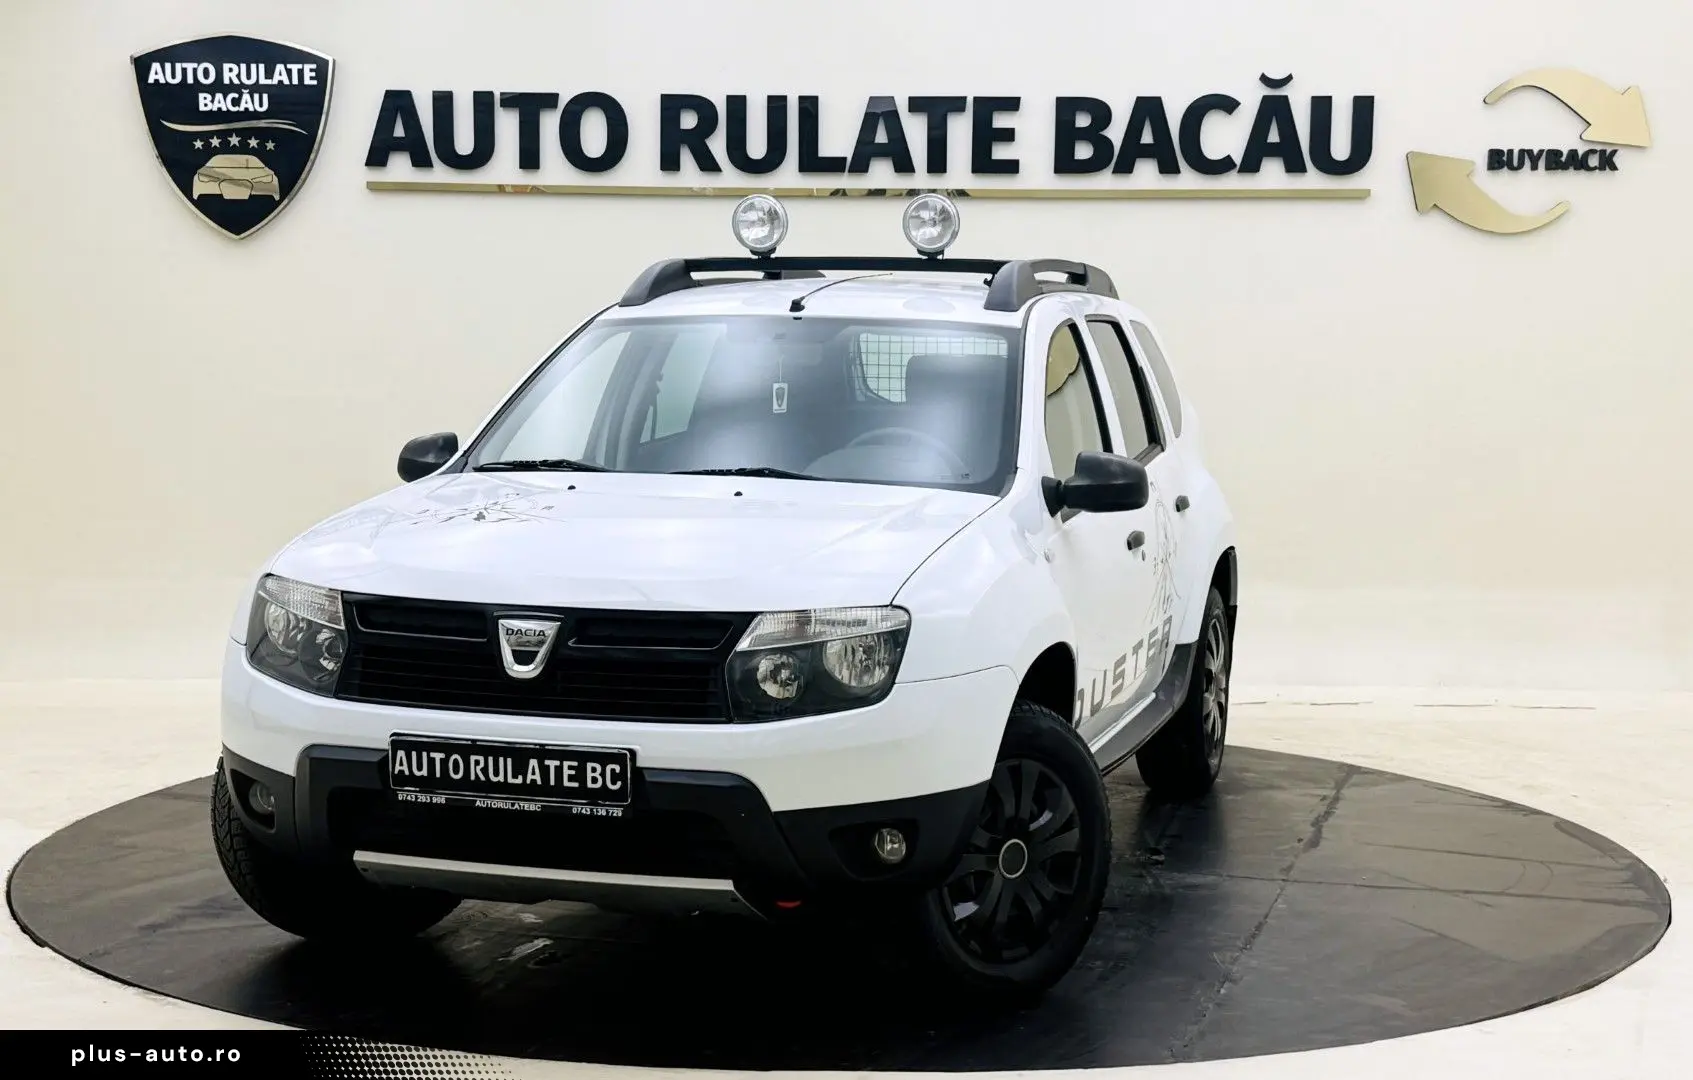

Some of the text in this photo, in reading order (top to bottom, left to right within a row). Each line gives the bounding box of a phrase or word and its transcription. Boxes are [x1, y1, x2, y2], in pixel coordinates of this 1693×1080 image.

[148, 62, 318, 86] AUTO RULATE
[198, 88, 269, 112] BACĂU
[365, 72, 1375, 176] AUTO RULATE BACĂU
[1486, 148, 1619, 171] BUYBACK
[505, 628, 547, 637] DACIA
[394, 750, 622, 791] AUTO RULATE BC
[398, 793, 416, 802] 0743
[417, 795, 431, 803] 293
[475, 799, 542, 812] AUTORULATEBC
[572, 807, 591, 815] 0743
